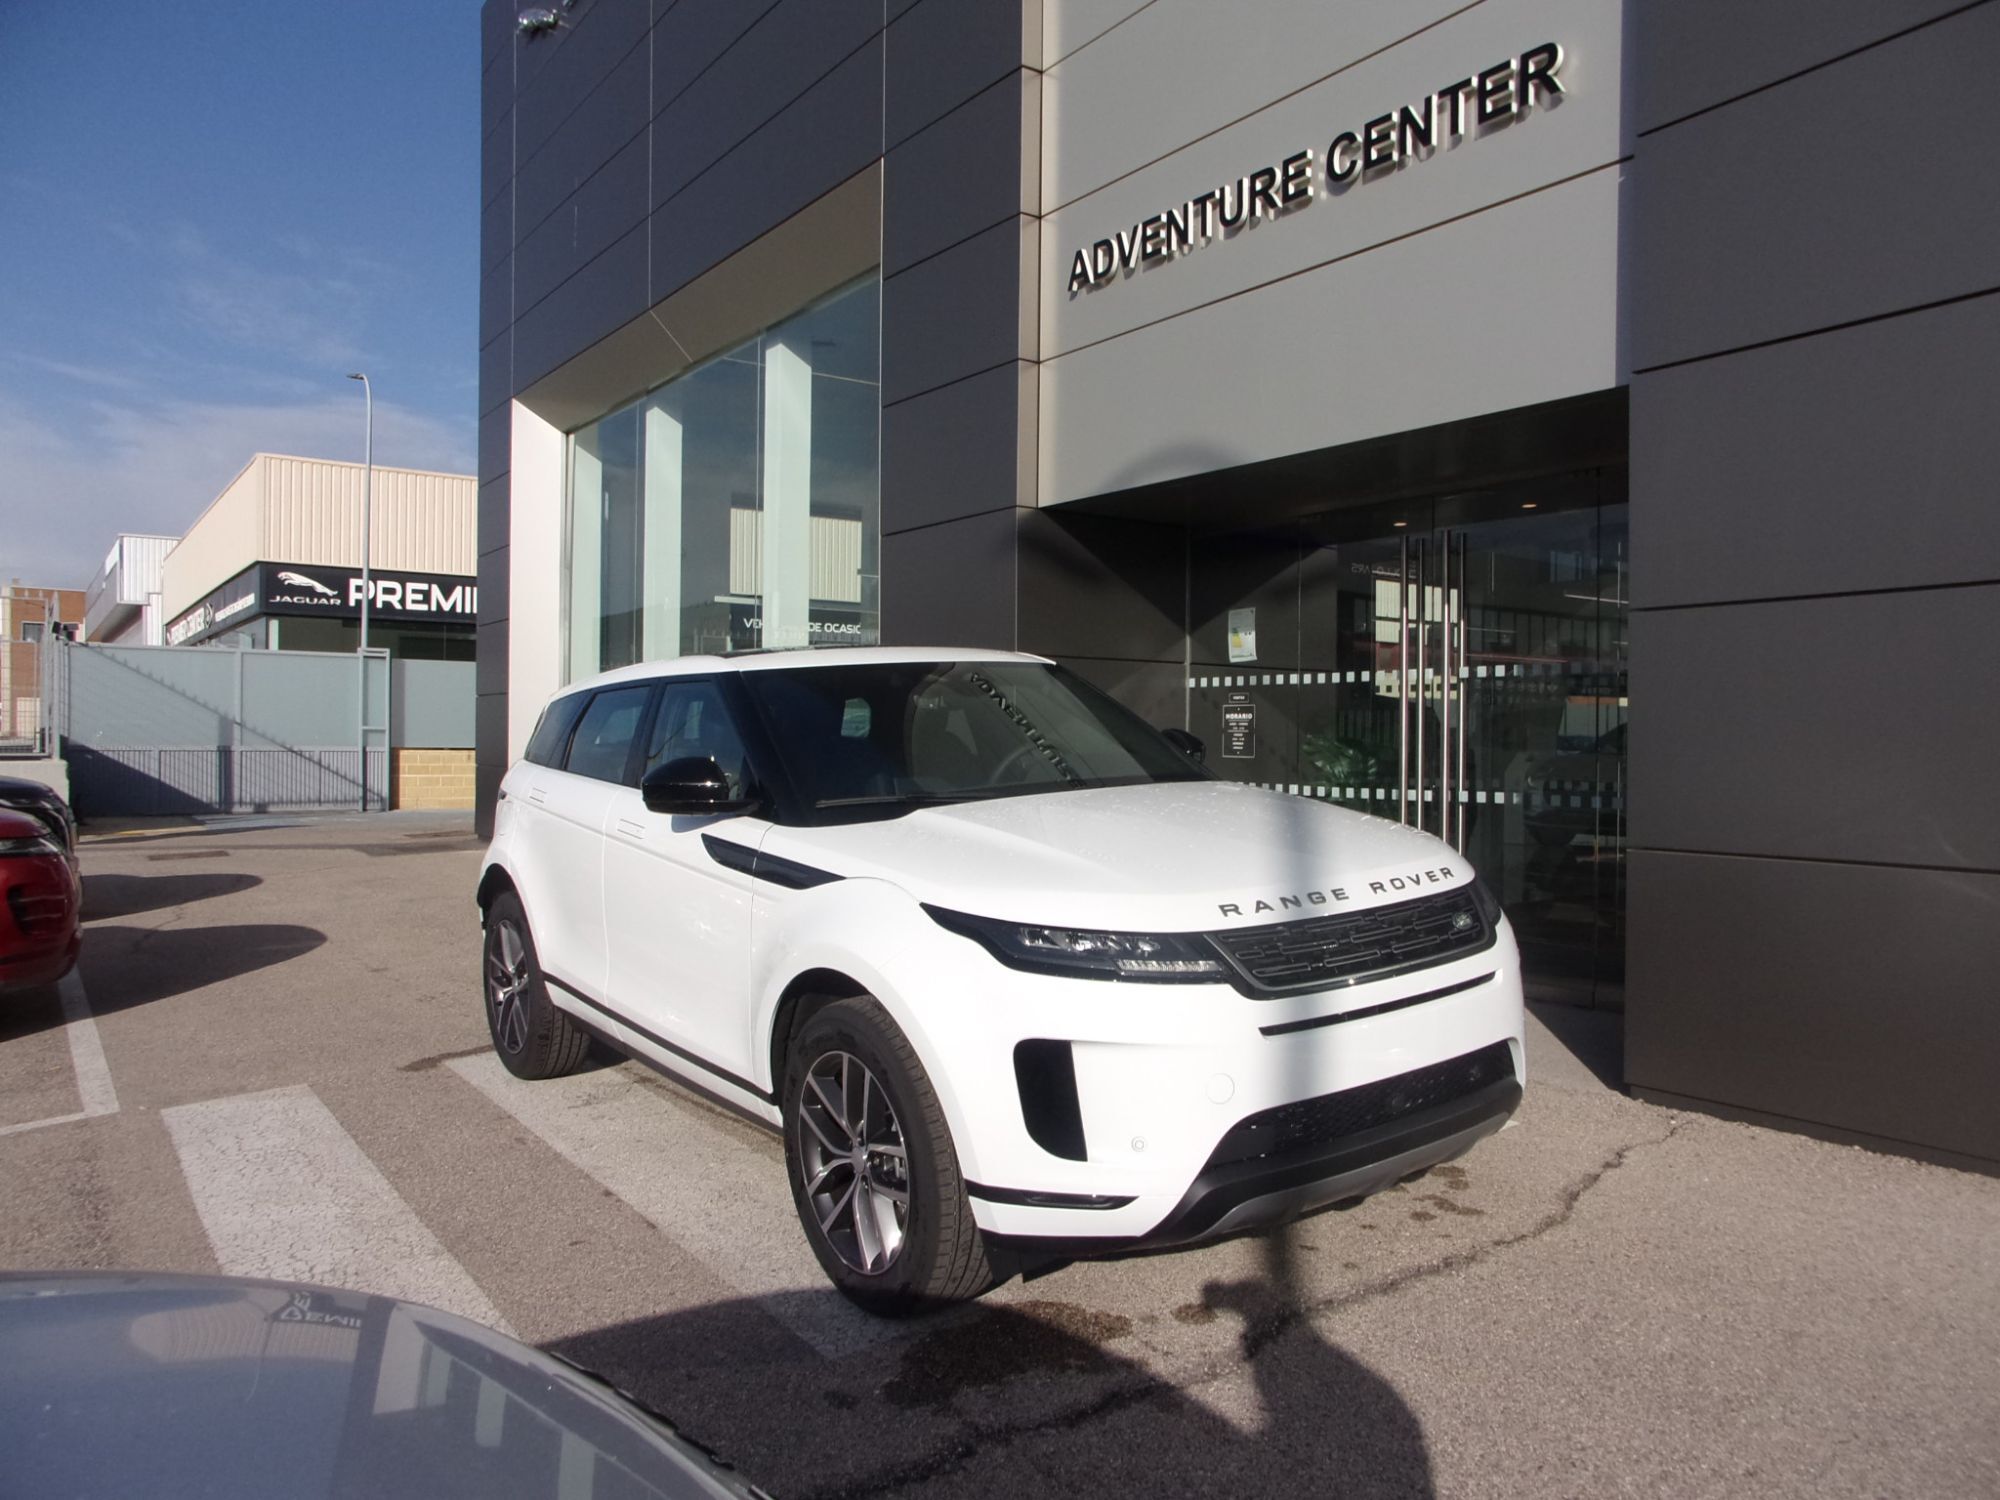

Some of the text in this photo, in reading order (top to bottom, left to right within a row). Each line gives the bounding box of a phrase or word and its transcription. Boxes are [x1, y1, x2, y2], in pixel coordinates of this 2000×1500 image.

[1067, 41, 1566, 294] ADVENTURE CENTER
[269, 577, 478, 614] JAGUAR PREMI
[1218, 866, 1455, 917] RANGE ROVER
